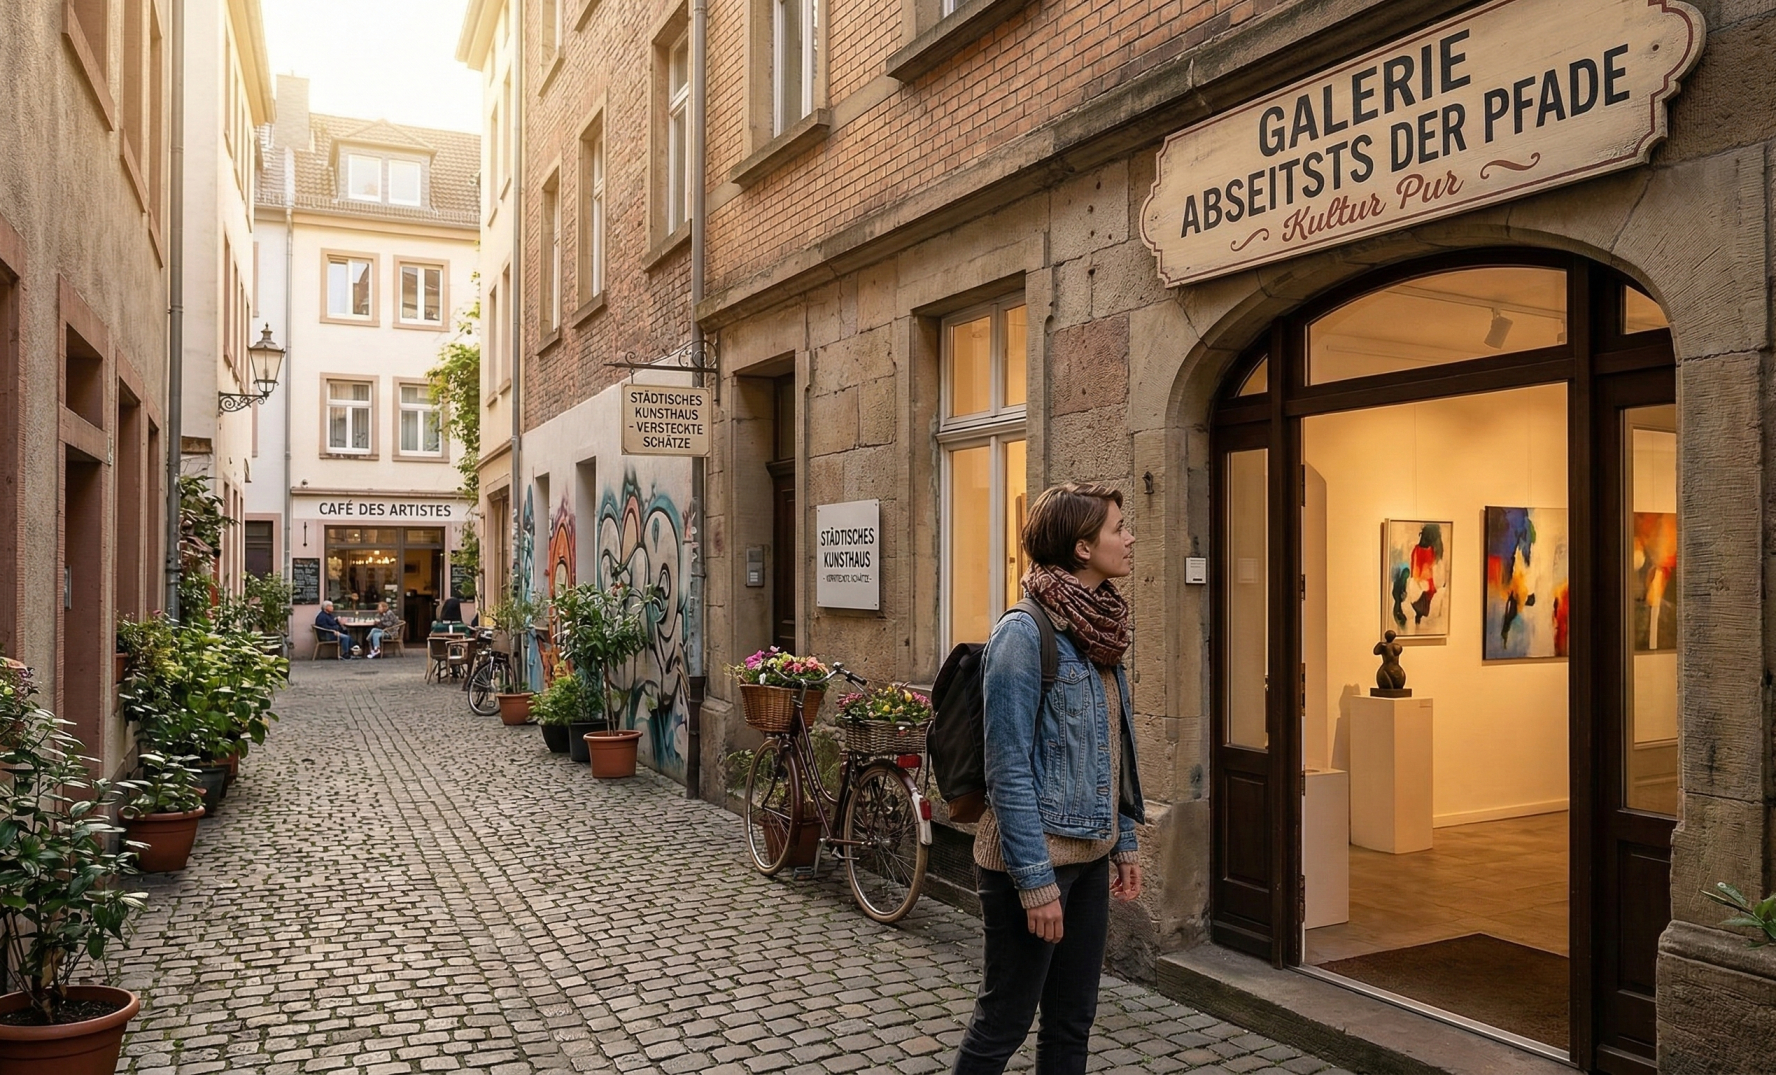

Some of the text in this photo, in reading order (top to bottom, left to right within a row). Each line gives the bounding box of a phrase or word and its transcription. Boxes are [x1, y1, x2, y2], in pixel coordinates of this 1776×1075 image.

[1258, 29, 1471, 157] GALERIE
[1181, 43, 1630, 238] ABSEITSTS DER PFADE
[1281, 168, 1464, 243] Kultur Pur
[631, 390, 702, 406] STÄDTISCHES
[635, 407, 698, 420] KUNSTHAUS
[636, 422, 703, 434] VERSTECKTE
[643, 435, 690, 448] SCHÄTZE
[319, 499, 452, 517] CAFÉ DES ARTISTES
[824, 551, 870, 567] KUNSTHAUS
